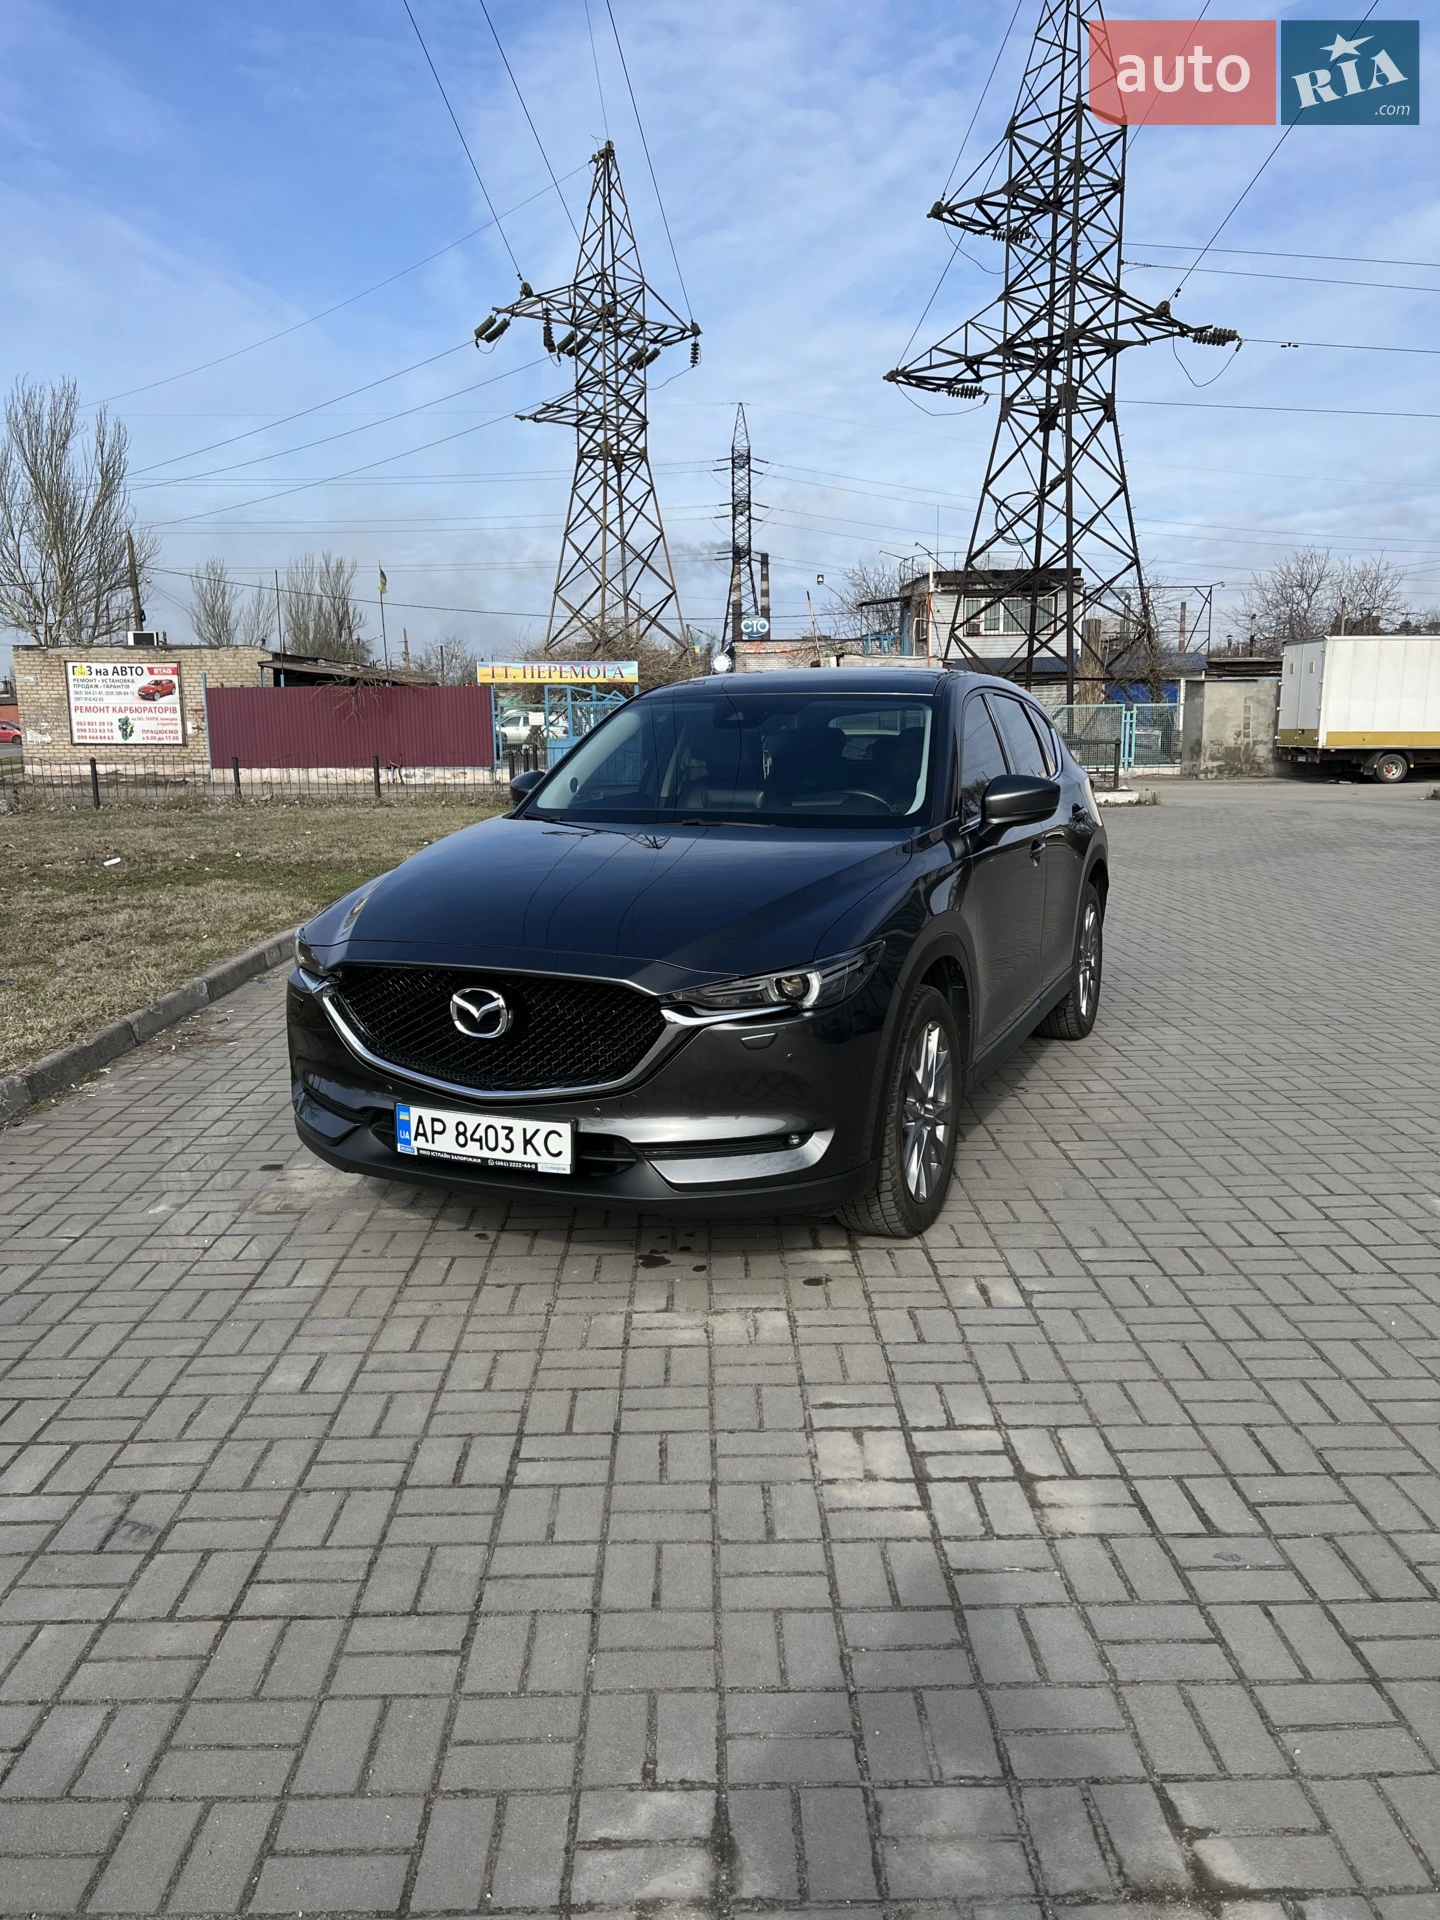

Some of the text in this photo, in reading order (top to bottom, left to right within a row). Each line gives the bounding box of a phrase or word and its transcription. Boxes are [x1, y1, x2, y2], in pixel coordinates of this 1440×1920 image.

[741, 620, 769, 632] СТО
[95, 668, 108, 676] на
[112, 666, 144, 676] АВТО
[522, 665, 625, 679] ПЕРЕМОГА
[112, 706, 178, 714] КАРБЮРАТОРІВ
[400, 1130, 410, 1139] UA
[413, 1115, 564, 1158] AP 8403 KC
